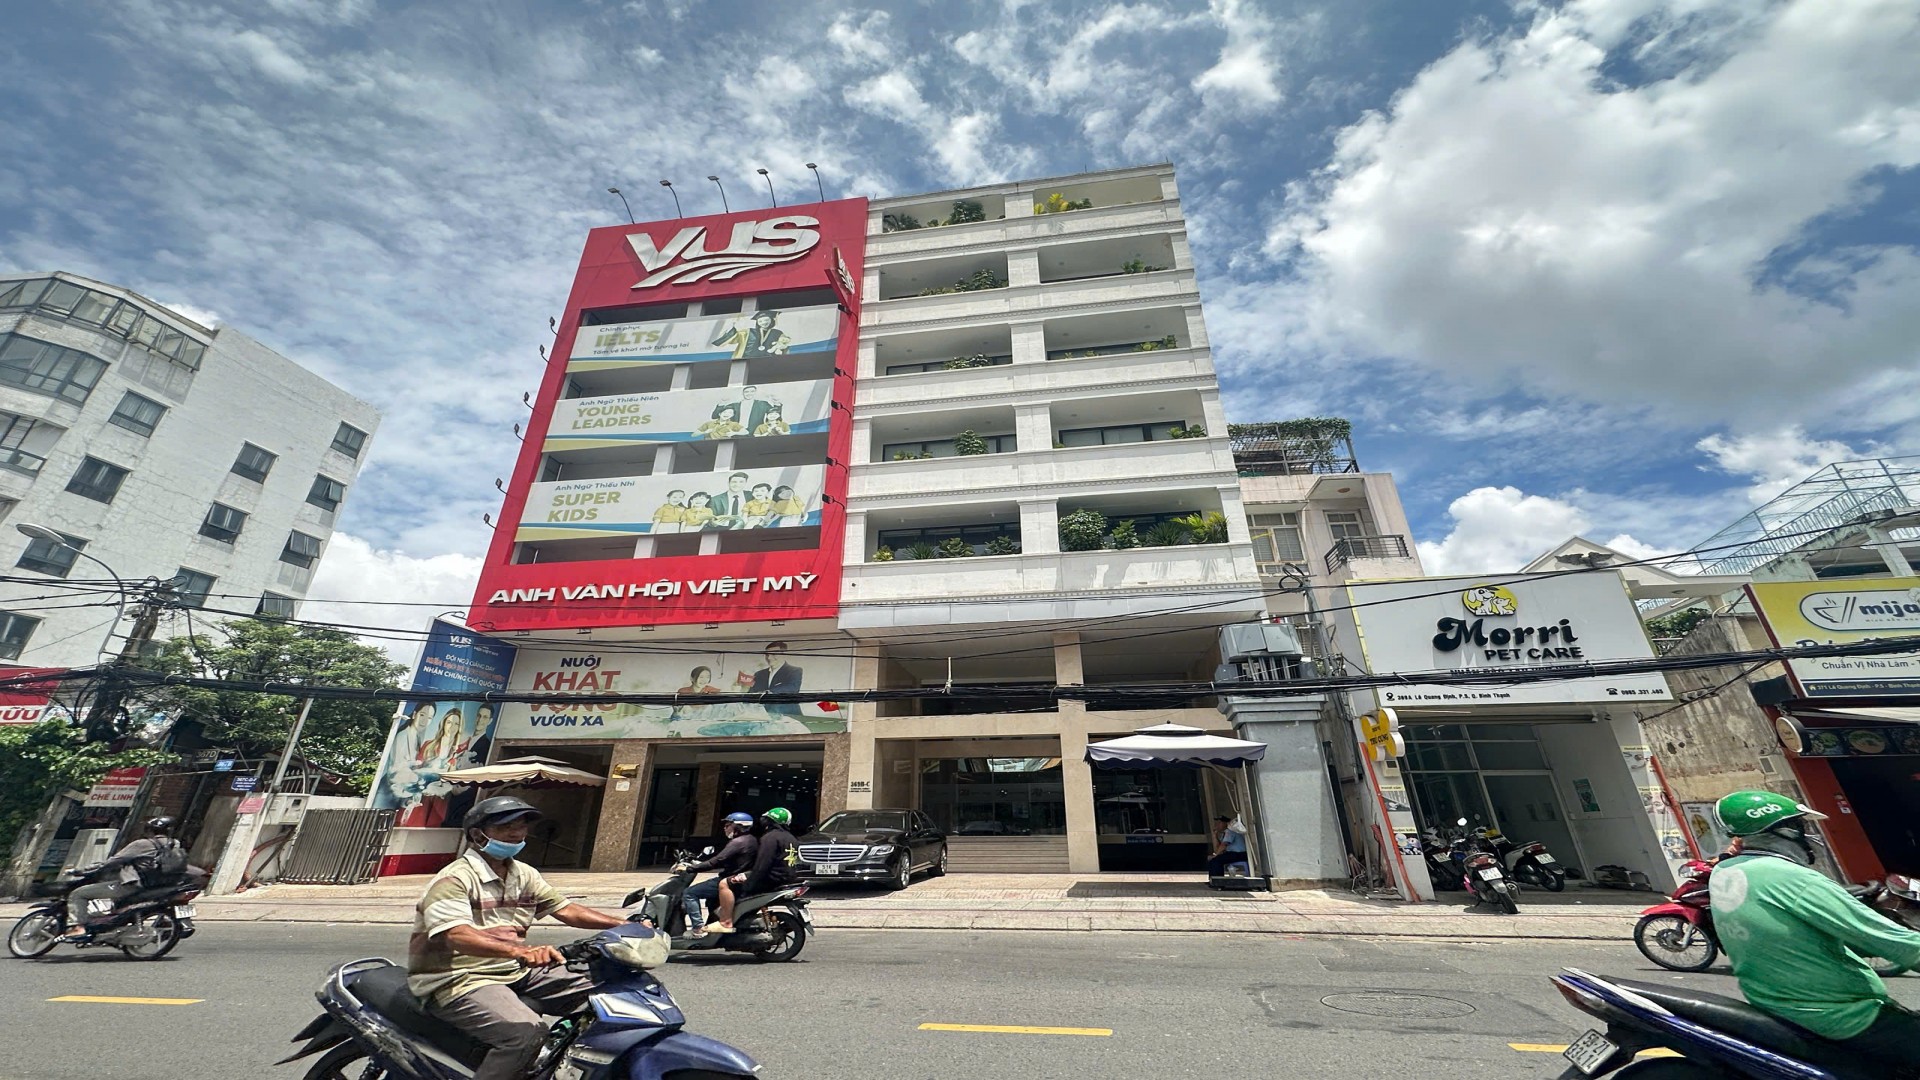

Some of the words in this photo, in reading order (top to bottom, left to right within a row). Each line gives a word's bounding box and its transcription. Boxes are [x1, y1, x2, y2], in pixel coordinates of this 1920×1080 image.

[626, 216, 820, 273] VUS
[595, 330, 661, 347] IELTS
[577, 403, 641, 418] YOUNG
[572, 414, 652, 430] LEADERS
[574, 483, 592, 491] Ngữ
[552, 491, 622, 507] SUPER
[547, 507, 599, 522] KIDS
[488, 587, 556, 604] ANH
[562, 583, 625, 600] VĂN
[628, 578, 682, 600] HỘI
[687, 576, 757, 598] VIỆT
[763, 572, 818, 591] MỸ
[1432, 617, 1579, 651] Morri
[561, 655, 602, 668] NUÔI
[1484, 648, 1522, 661] PET
[1527, 646, 1584, 660] CARE
[1822, 660, 1852, 669] Chuẩn
[1855, 661, 1865, 670] Vị
[1867, 660, 1886, 668] Nhà
[1888, 660, 1908, 668] Làm
[423, 666, 444, 676] NHẬN
[444, 671, 467, 682] CHỨNG
[479, 679, 495, 689] QUỐC
[533, 666, 621, 691] KHÁT
[530, 714, 578, 727] VƯƠN
[581, 716, 604, 726] XA
[112, 793, 134, 801] LINH
[1746, 803, 1783, 819] Grab
